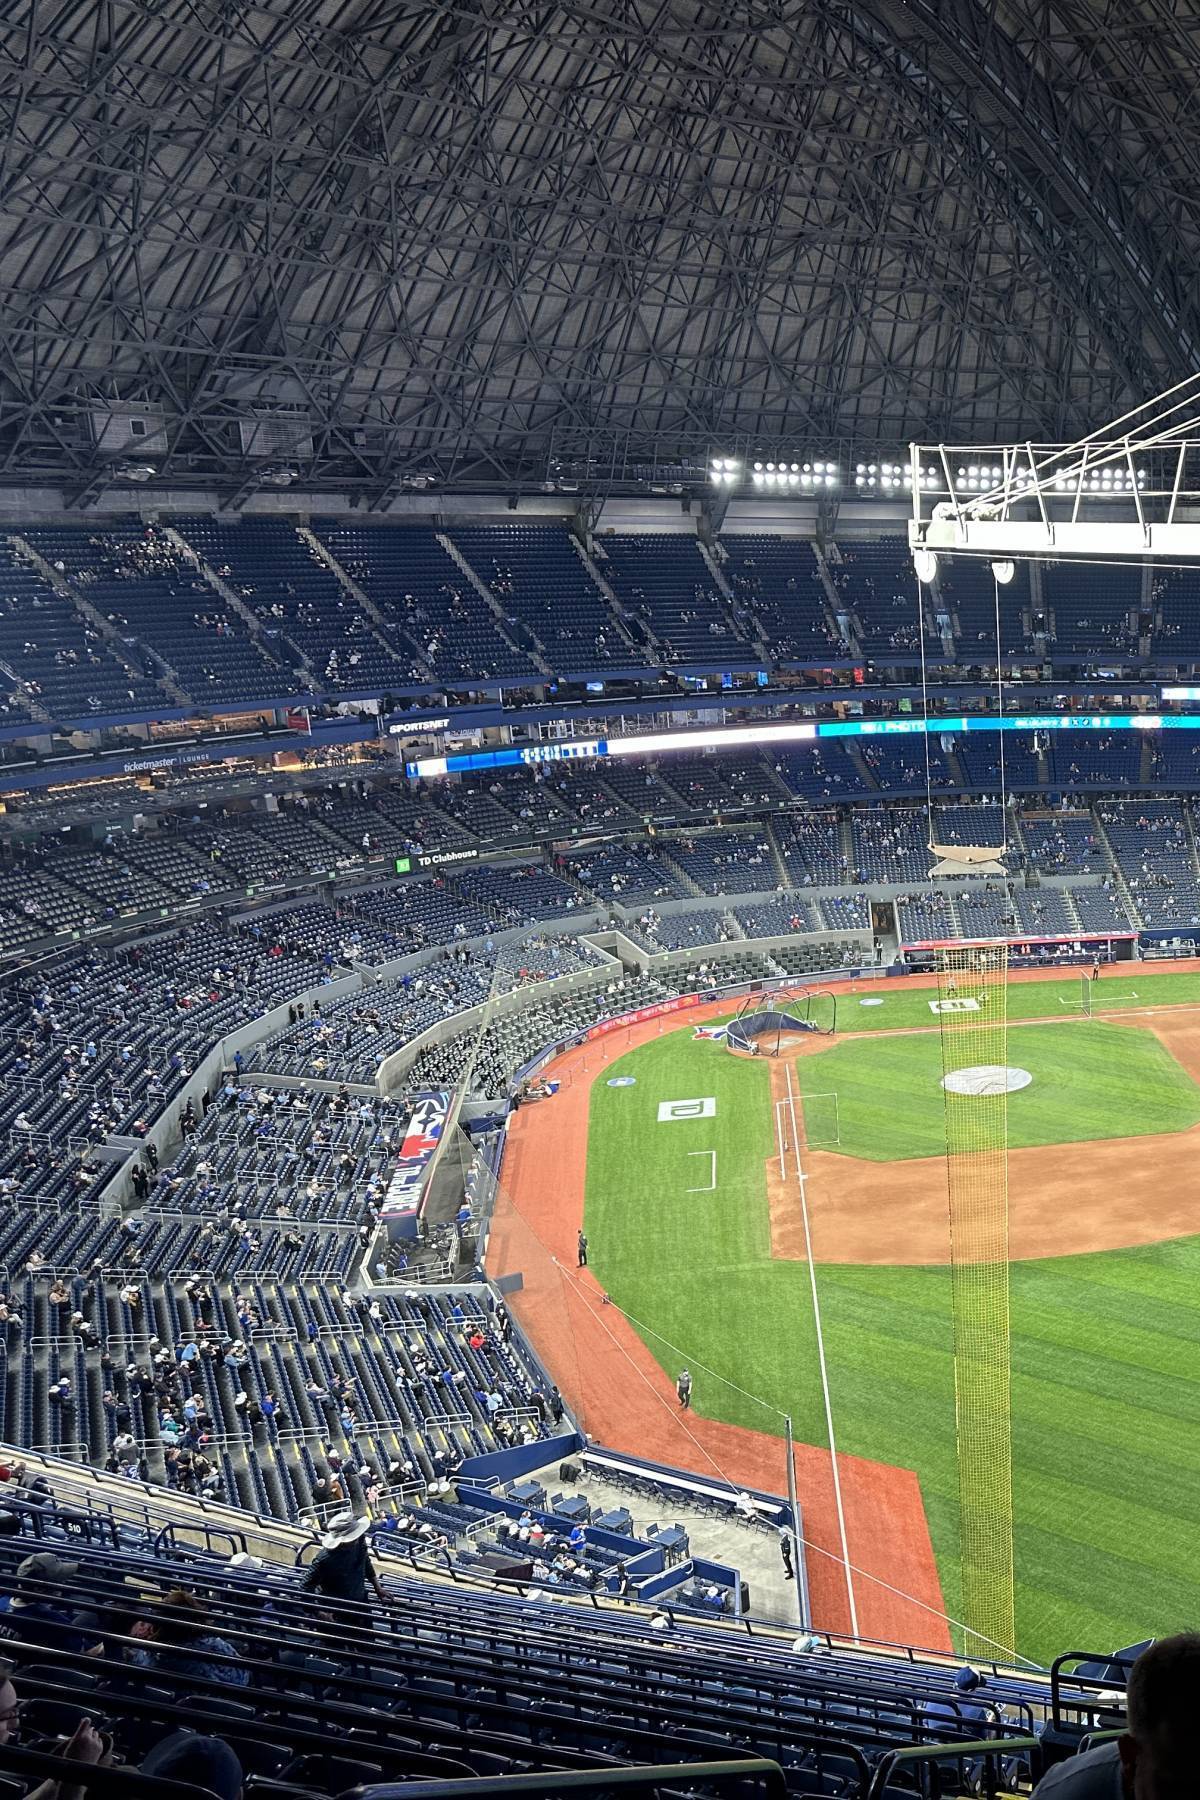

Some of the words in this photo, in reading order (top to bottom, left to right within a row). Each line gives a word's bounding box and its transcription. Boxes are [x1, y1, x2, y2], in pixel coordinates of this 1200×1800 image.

[389, 718, 450, 734] SPORTSNET
[124, 757, 177, 772] ticketmaster
[183, 753, 210, 763] LOUNGE
[417, 857, 431, 866] TD
[432, 850, 477, 863] Clubhouse
[381, 1182, 423, 1214] CORE
[68, 1522, 81, 1534] 510
